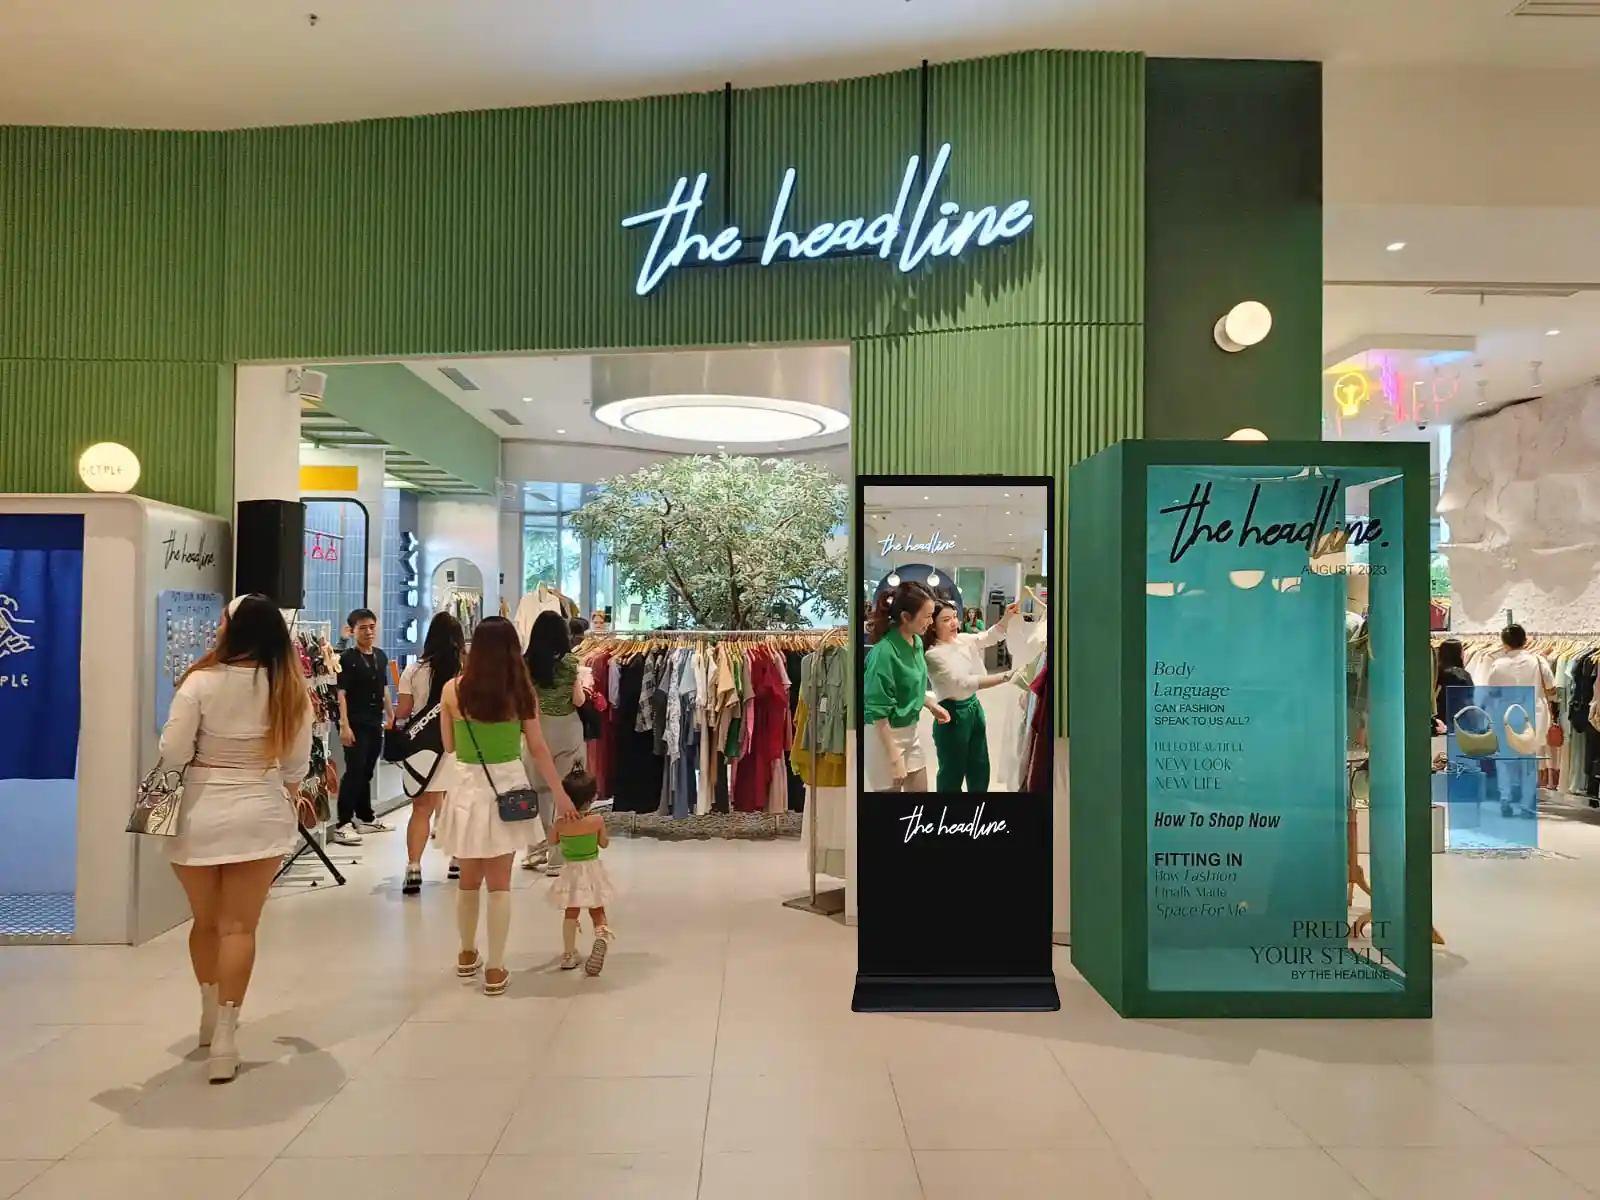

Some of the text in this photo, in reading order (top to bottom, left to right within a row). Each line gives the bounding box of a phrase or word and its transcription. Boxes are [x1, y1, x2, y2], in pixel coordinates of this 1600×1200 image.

[621, 142, 1033, 297] the headline
[1159, 478, 1389, 564] the headline.
[162, 530, 181, 570] the
[878, 530, 956, 557] the headline
[1301, 564, 1388, 576] AUGUST 2023
[1153, 660, 1196, 680] Body
[1153, 681, 1232, 701] Language
[1154, 703, 1225, 713] CAN FASHION
[1154, 716, 1250, 726] SPEAK TO US ALL?
[1155, 757, 1232, 771] NEW LOOK
[1155, 776, 1222, 790] NEW LIFE
[899, 801, 1010, 843] the headline.
[1154, 811, 1281, 832] How To Shop Now
[1154, 852, 1242, 867] FITTING IN
[1155, 868, 1237, 882] How Fashion
[1196, 887, 1227, 898] Made
[1157, 902, 1247, 919] Space For Me
[1292, 920, 1392, 940] PREDICT
[1250, 945, 1391, 965] YOUR STYLE
[1291, 970, 1390, 980] BY THE HEADLINE
